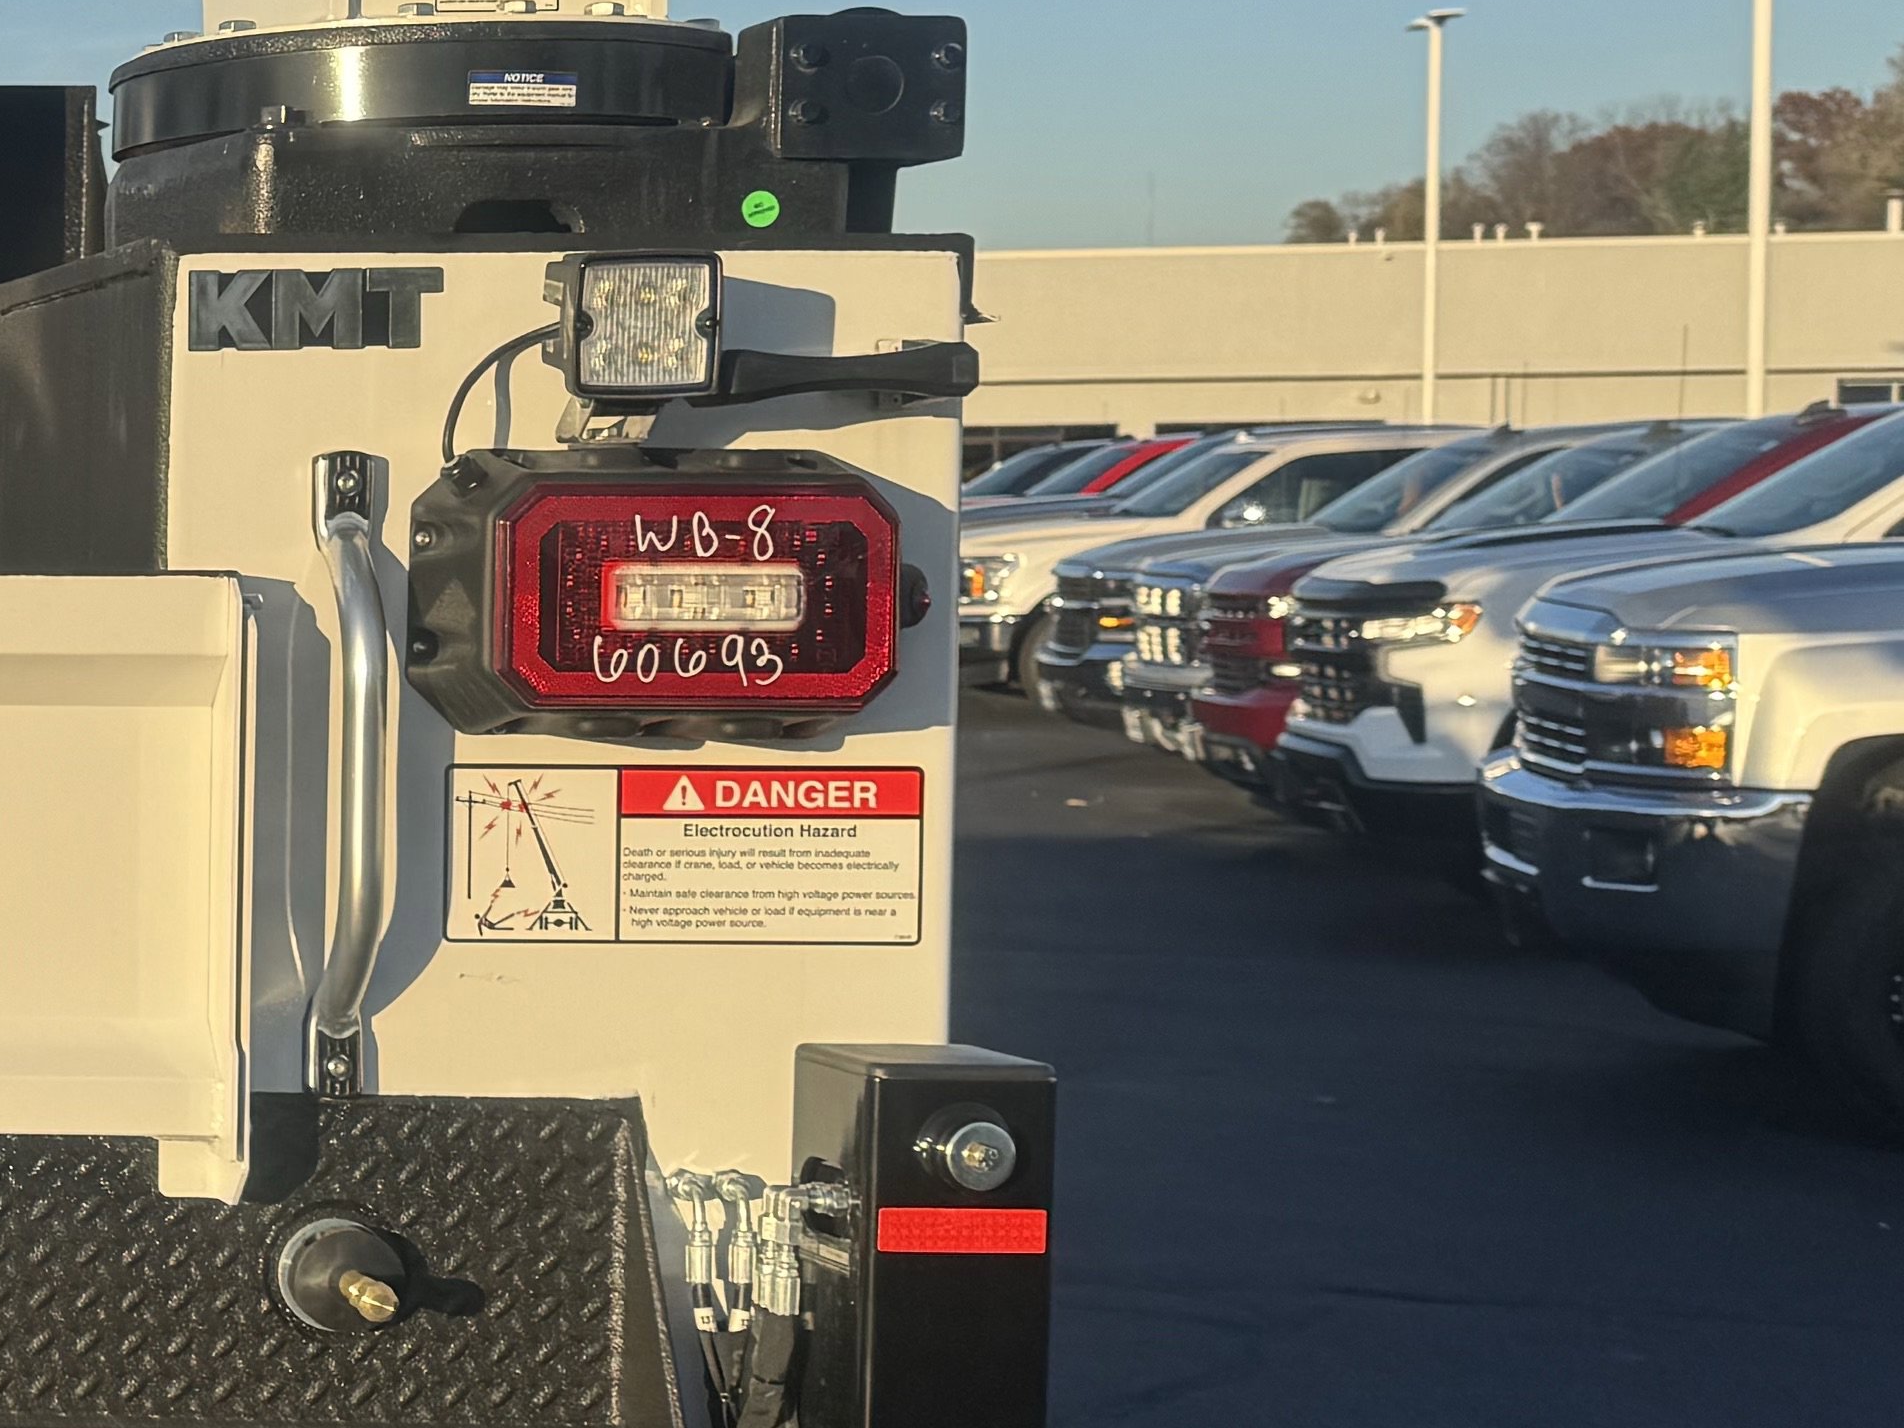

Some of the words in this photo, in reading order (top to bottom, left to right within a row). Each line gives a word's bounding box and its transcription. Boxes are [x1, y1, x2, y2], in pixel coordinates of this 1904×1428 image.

[503, 72, 545, 83] NOTICE
[189, 267, 444, 351] KMT
[593, 634, 784, 687] 60693
[714, 780, 878, 809] DANGER
[683, 824, 793, 838] Electrocution
[800, 824, 857, 838] Hazard
[623, 847, 653, 857] Death
[656, 849, 666, 858] or
[670, 848, 706, 858] serious
[709, 848, 737, 860] injury
[739, 848, 756, 858] will
[758, 848, 786, 858] result
[788, 848, 812, 858] from
[814, 848, 870, 860] inadequate
[622, 860, 672, 870] clearance
[746, 862, 757, 870] or
[759, 860, 794, 870] vehicle
[797, 860, 843, 871] becomes
[846, 861, 899, 873] electrically
[622, 872, 667, 883] charged.
[630, 888, 672, 898] Maintain
[676, 888, 697, 898] safe
[700, 889, 749, 899] clearance
[752, 889, 774, 899] from
[778, 889, 800, 902] high
[802, 890, 839, 902] voltage
[842, 891, 872, 901] power
[629, 906, 659, 915] Never
[662, 906, 710, 917] approach
[712, 906, 748, 916] vehicle
[751, 908, 761, 916] or
[764, 907, 786, 916] load
[797, 907, 851, 918] equipment
[631, 918, 653, 929] high
[656, 918, 693, 930] voltage
[695, 919, 726, 929] power
